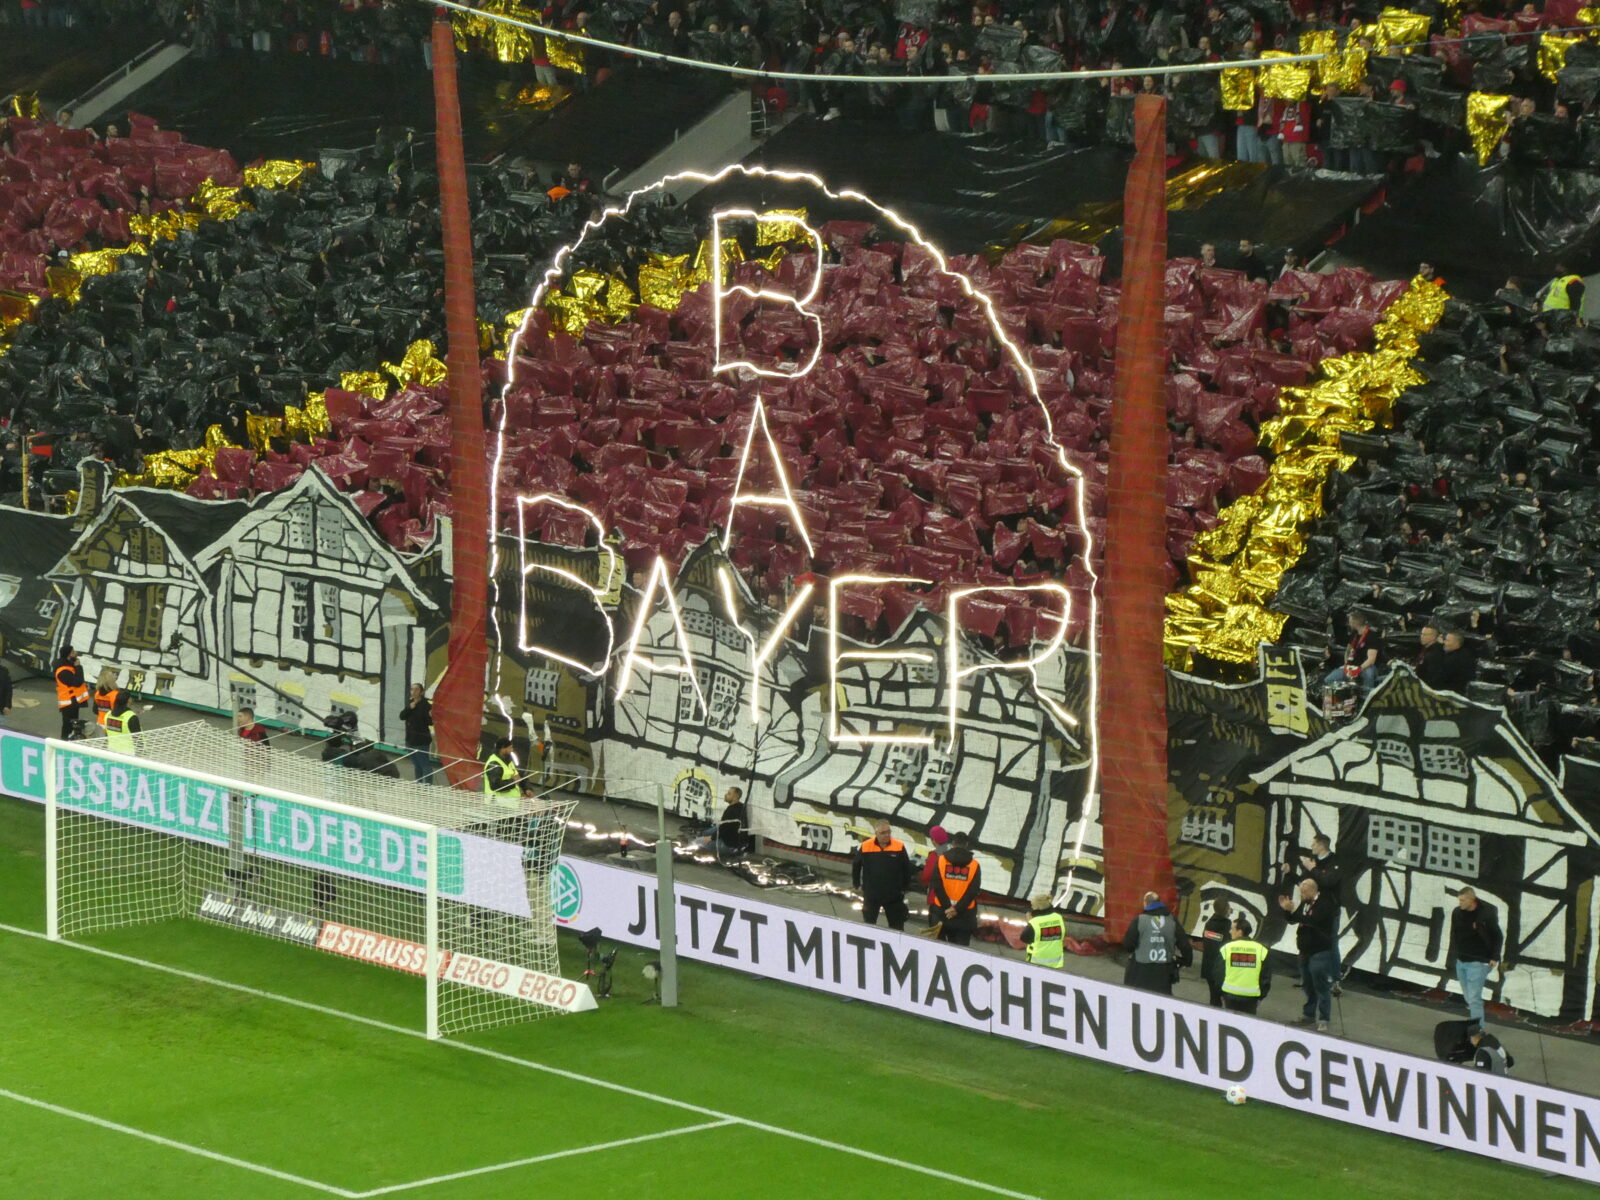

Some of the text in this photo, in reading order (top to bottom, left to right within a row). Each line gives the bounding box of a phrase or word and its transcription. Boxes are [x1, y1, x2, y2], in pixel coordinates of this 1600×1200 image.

[516, 494, 1078, 756] BAYER
[200, 893, 318, 942] bwin bwin bwin
[337, 929, 427, 971] STRAUSS
[1149, 948, 1167, 962] 02
[451, 957, 578, 1007] ERGO ERGO
[627, 884, 768, 965] JTZT
[783, 919, 1109, 1051] MITMACHEN
[1130, 1001, 1255, 1083] UND
[1274, 1040, 1600, 1169] GEWINNEN
